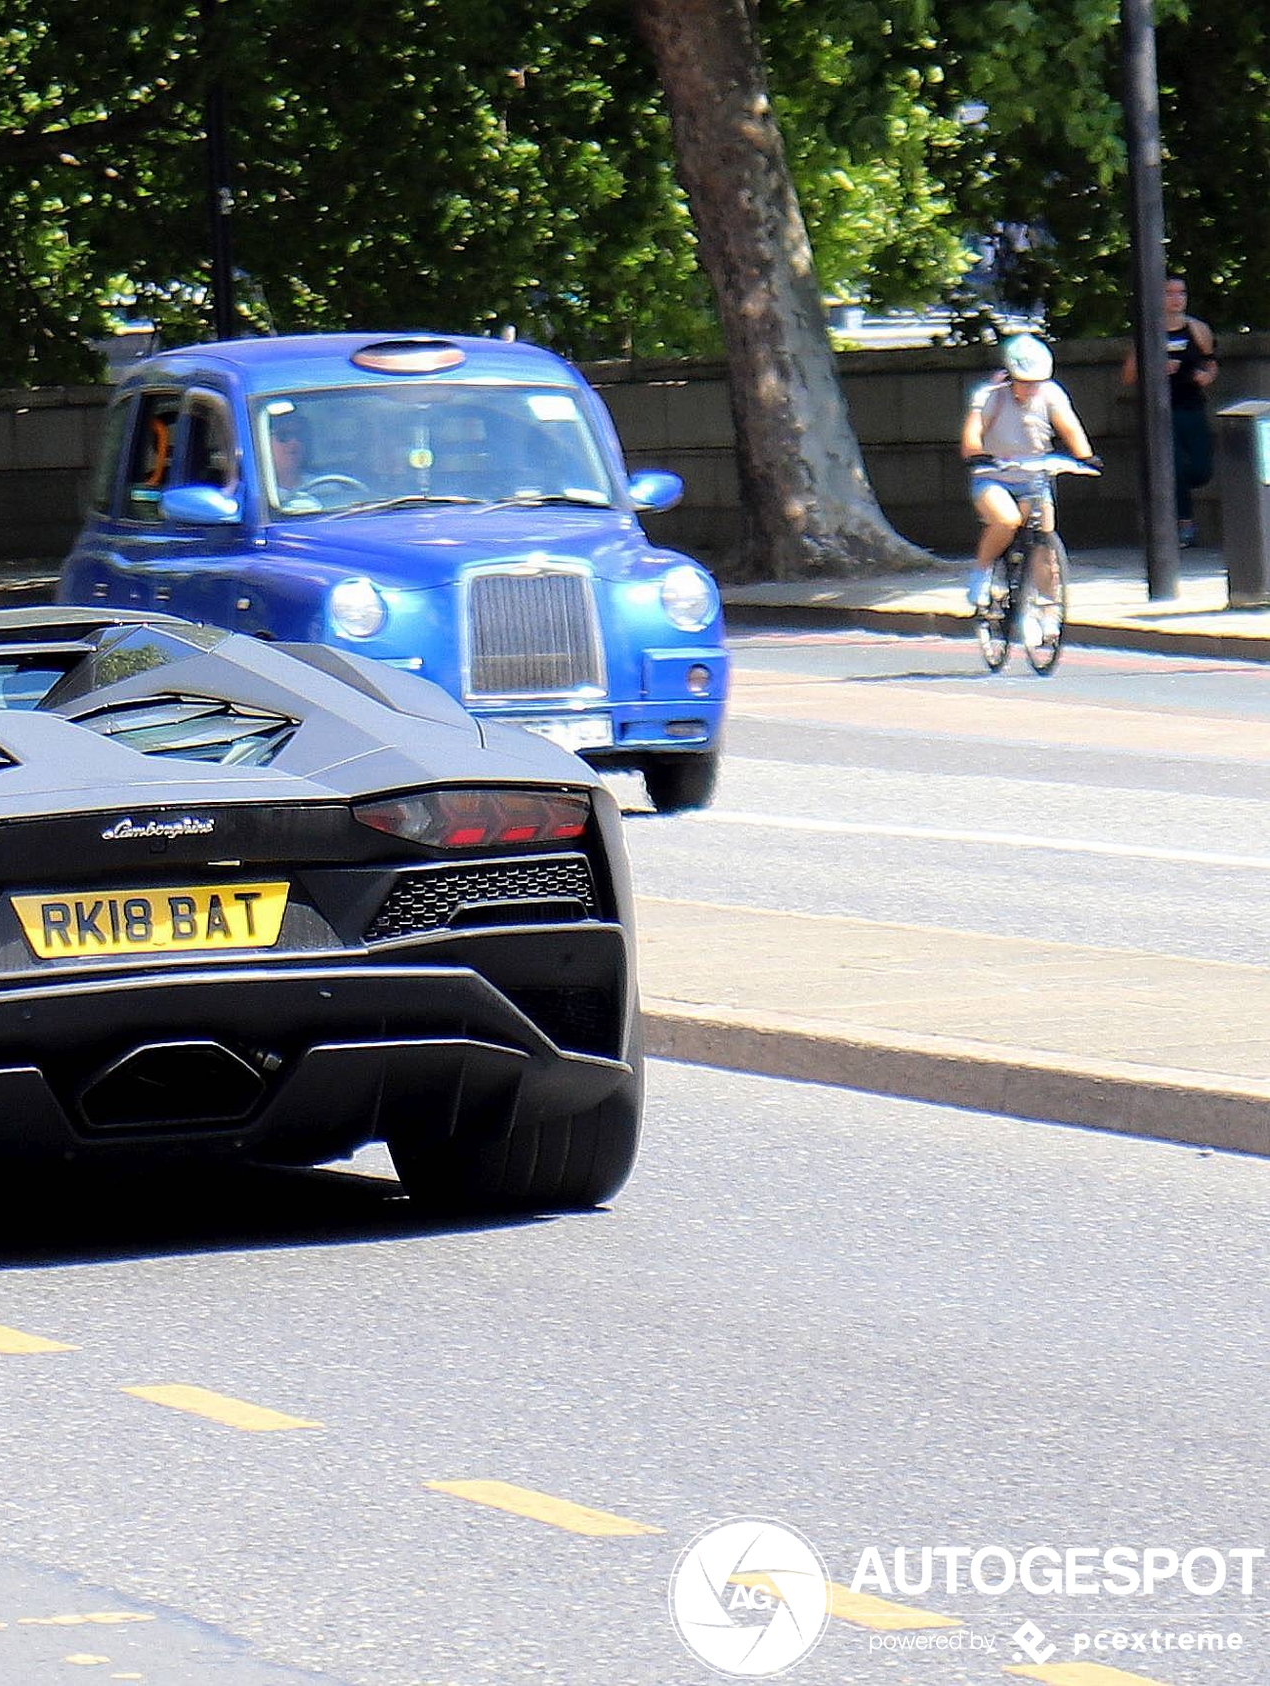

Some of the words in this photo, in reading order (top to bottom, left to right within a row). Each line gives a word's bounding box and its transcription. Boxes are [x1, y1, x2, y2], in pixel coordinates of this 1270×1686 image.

[101, 817, 215, 840] Lamborghini
[41, 898, 154, 948] RK18
[168, 892, 262, 940] BAT
